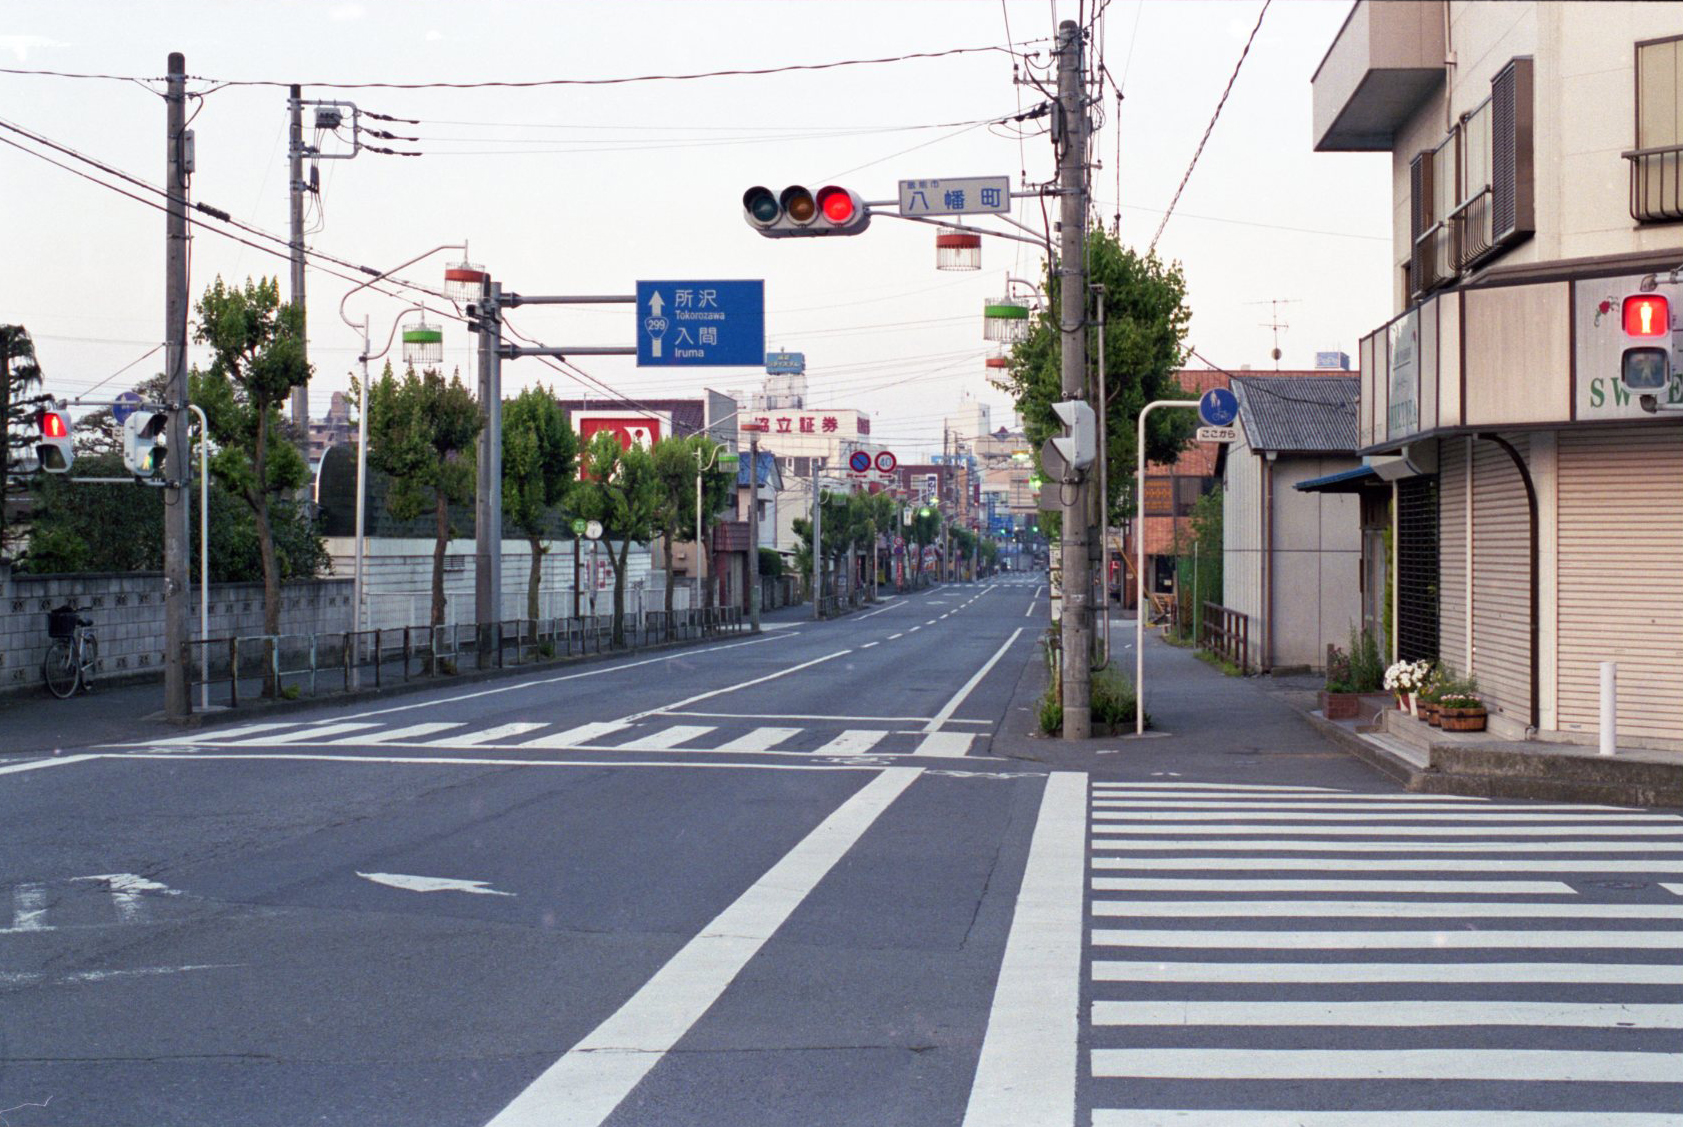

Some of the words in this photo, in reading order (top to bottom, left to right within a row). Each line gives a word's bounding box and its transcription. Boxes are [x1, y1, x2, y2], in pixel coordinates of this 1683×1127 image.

[909, 188, 1001, 211] 八幡町
[675, 289, 717, 308] 所沢
[675, 310, 725, 321] Tokorozawa
[648, 319, 666, 331] 299
[675, 327, 718, 346] 入間
[675, 347, 704, 358] Iruma
[1201, 429, 1236, 439] ここから
[879, 456, 892, 468] 40
